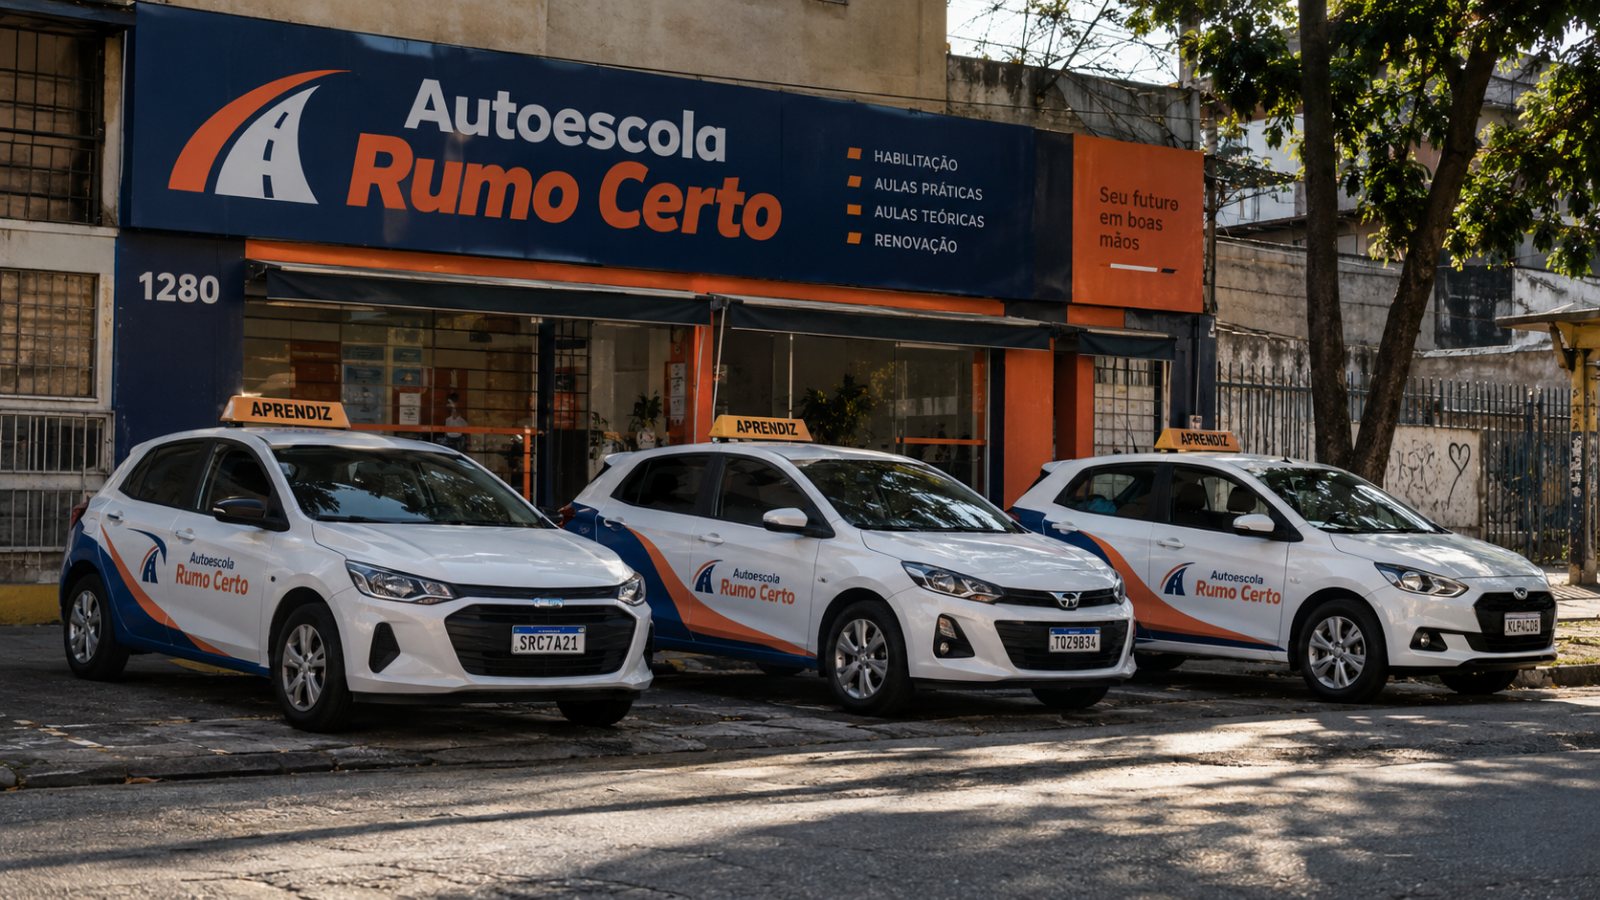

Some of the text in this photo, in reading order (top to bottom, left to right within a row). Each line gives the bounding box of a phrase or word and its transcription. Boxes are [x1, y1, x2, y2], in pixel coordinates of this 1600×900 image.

[404, 78, 726, 162] Autoescola
[874, 149, 958, 172] HABILITAÇÃO
[346, 133, 782, 241] Rumo Certo
[874, 177, 983, 201] AULAS PRÁTICAS
[1100, 186, 1179, 212] Seu futuro
[874, 205, 985, 228] AULAS TEÓRICAS
[1100, 210, 1163, 231] em boas
[874, 233, 958, 255] RENOVAÇÃO
[1099, 231, 1140, 250] mãos
[139, 271, 220, 304] 1280
[251, 401, 333, 421] APRENDIZ
[736, 419, 798, 436] APRENDIZ
[1181, 432, 1230, 447] APRENDIZ
[189, 551, 235, 570] Autoescola
[175, 563, 249, 595] Rumo Certo
[733, 567, 780, 584] Autoescola
[1210, 570, 1264, 585] Autoescola
[720, 578, 796, 605] Rumo Certo
[1195, 579, 1282, 605] Rumo Certo
[520, 635, 578, 651] SRC7A21
